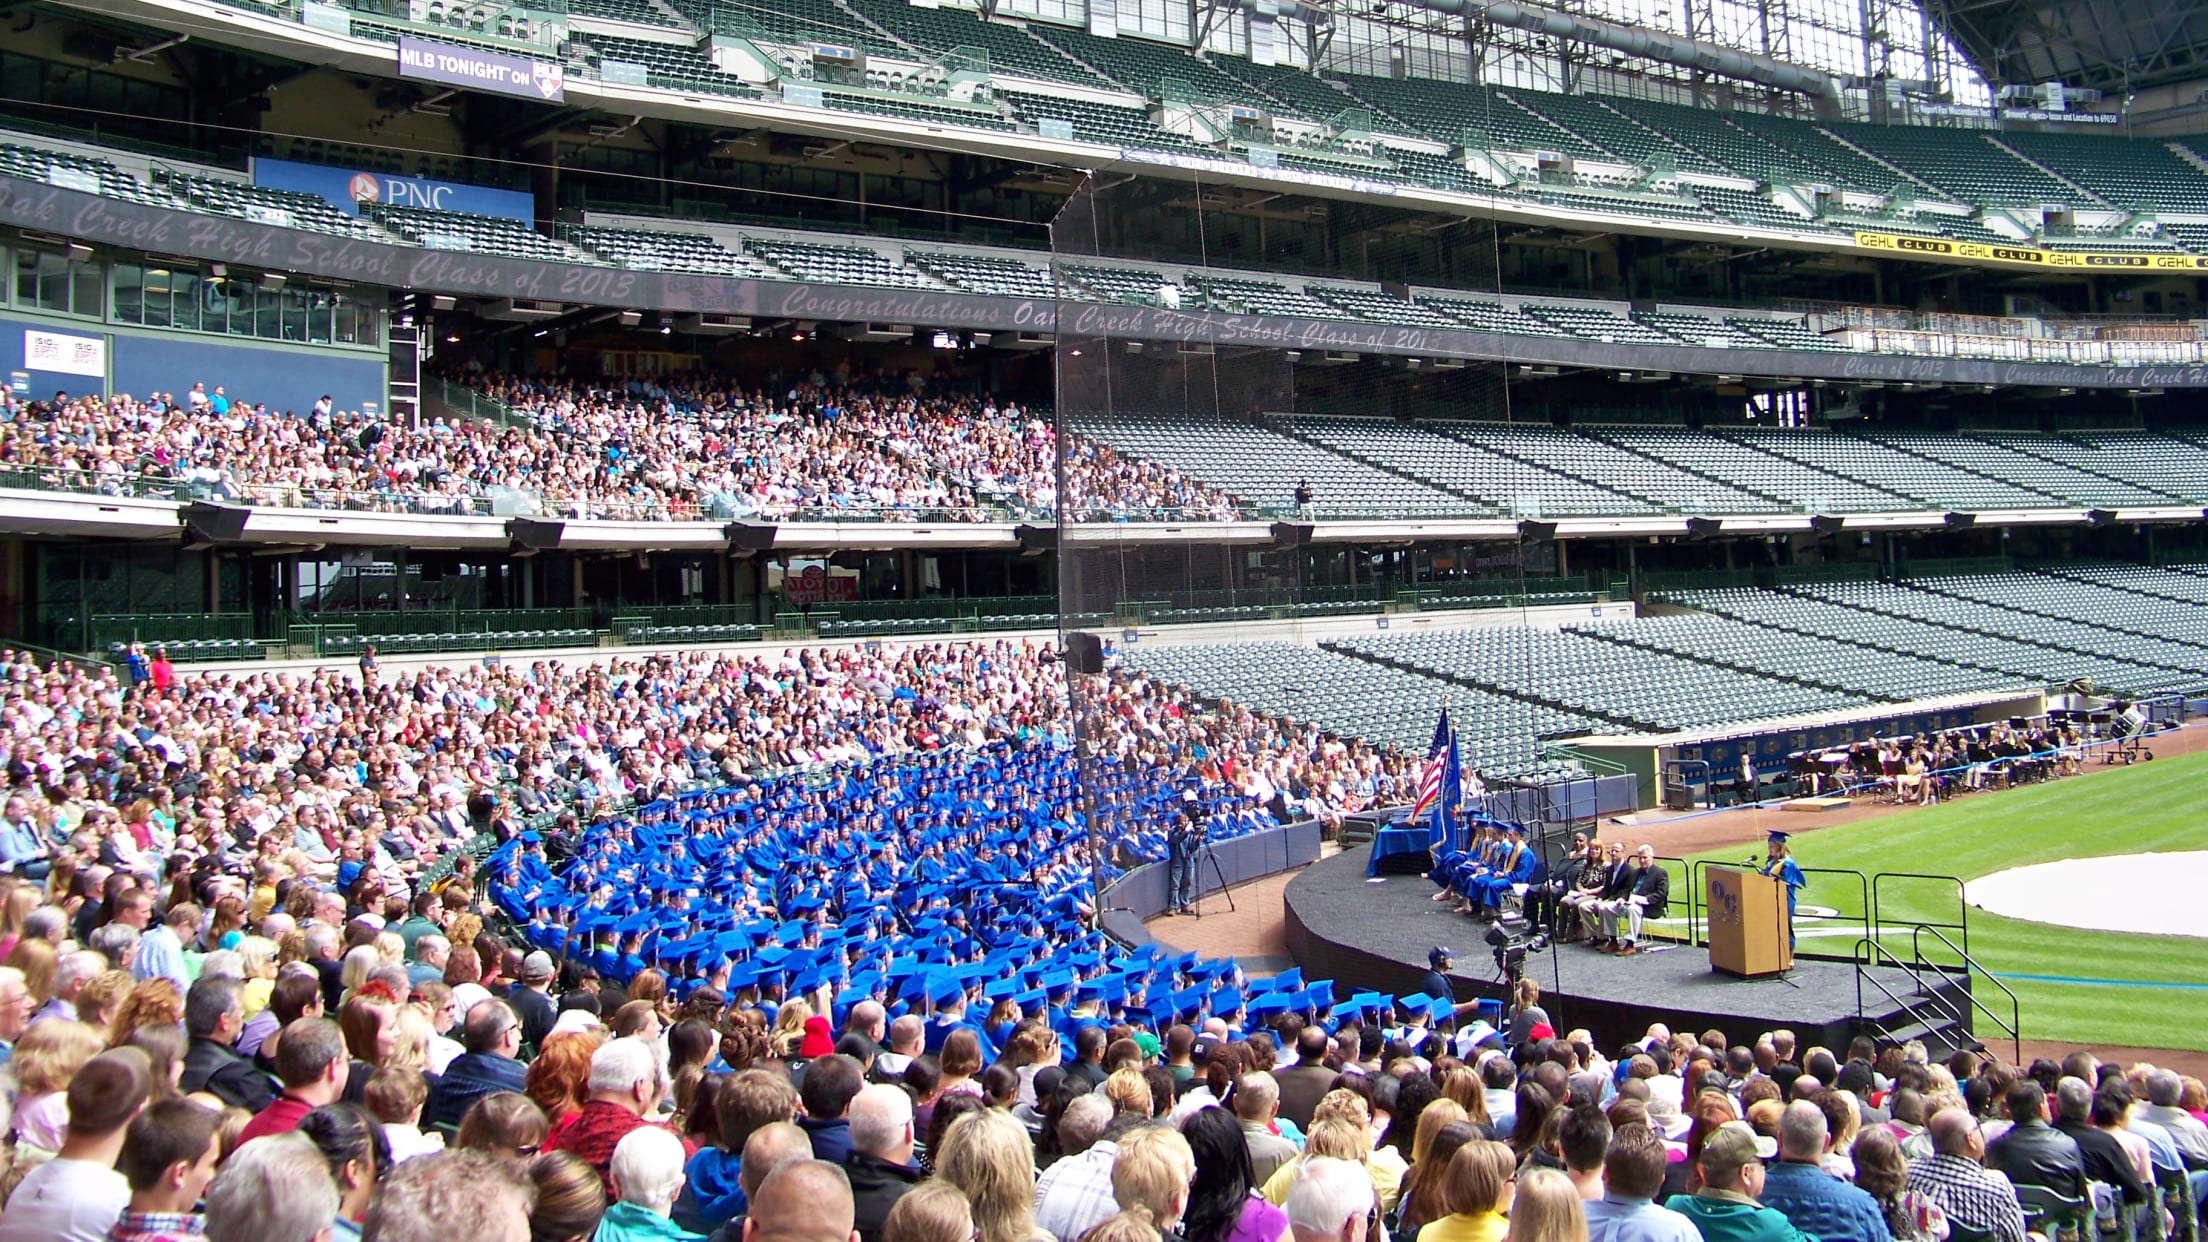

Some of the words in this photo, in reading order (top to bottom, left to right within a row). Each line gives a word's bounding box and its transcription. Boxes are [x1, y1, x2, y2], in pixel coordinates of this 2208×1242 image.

[400, 48, 435, 68] MLB
[437, 54, 505, 81] TONIGHT
[511, 71, 530, 85] ON
[385, 179, 453, 210] PNC
[72, 200, 171, 243] Creek
[187, 218, 277, 261] High
[288, 236, 396, 276] School
[408, 251, 499, 287] Class
[514, 264, 547, 298] of
[559, 268, 637, 299] 2013
[1860, 234, 1895, 249] GEHL
[1903, 240, 1946, 252] CLUB
[1959, 244, 1991, 258] GEHL
[1998, 250, 2037, 261] CLUB
[2049, 253, 2083, 266] GEHL
[2094, 256, 2142, 266] CLUB
[2157, 257, 2193, 268] GEHL
[780, 284, 1000, 323] Congratulations
[1075, 304, 1144, 334] Creek
[1152, 310, 1210, 340] High
[1220, 317, 1294, 340] School
[1301, 321, 1357, 348] Class
[1366, 327, 1387, 353] of
[1844, 357, 1884, 377] Class
[1890, 360, 1905, 379] of
[1910, 360, 1945, 377] 2013
[2105, 368, 2134, 385] Oak
[2140, 367, 2183, 387] Creek
